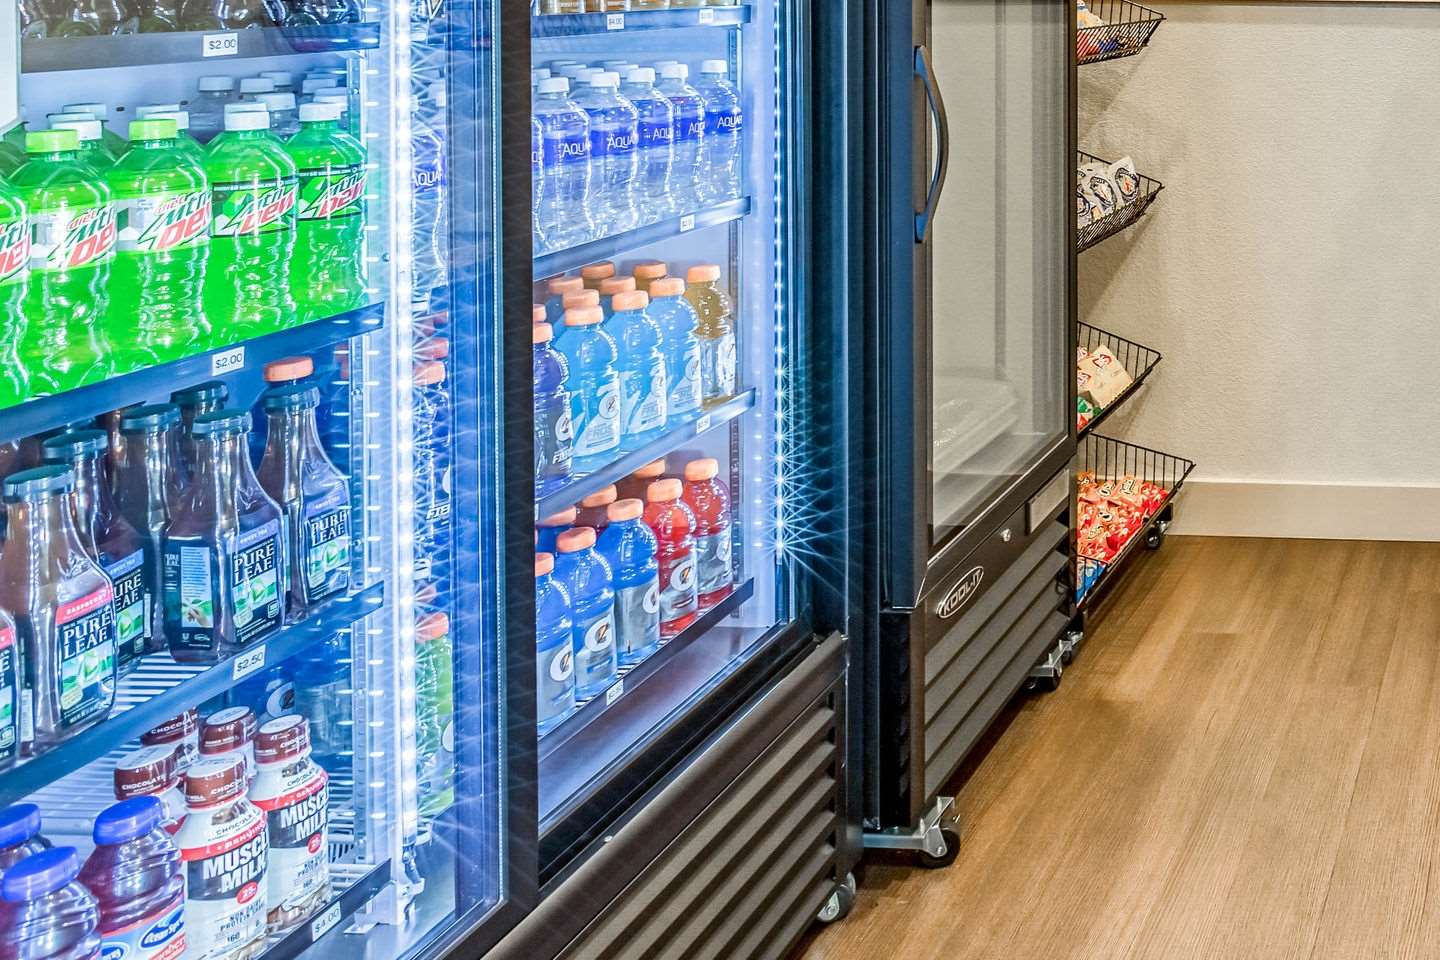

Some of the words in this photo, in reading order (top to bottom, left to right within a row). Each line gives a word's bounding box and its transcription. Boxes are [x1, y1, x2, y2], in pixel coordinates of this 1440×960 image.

[209, 39, 237, 50] $2.00
[215, 353, 243, 369] $2.00
[233, 542, 275, 573] PURE
[234, 557, 273, 586] LEAF
[114, 572, 142, 600] URE
[114, 590, 140, 611] EAF
[63, 612, 113, 646] PURE
[63, 626, 108, 660] LEAF
[237, 651, 263, 672] $2.50
